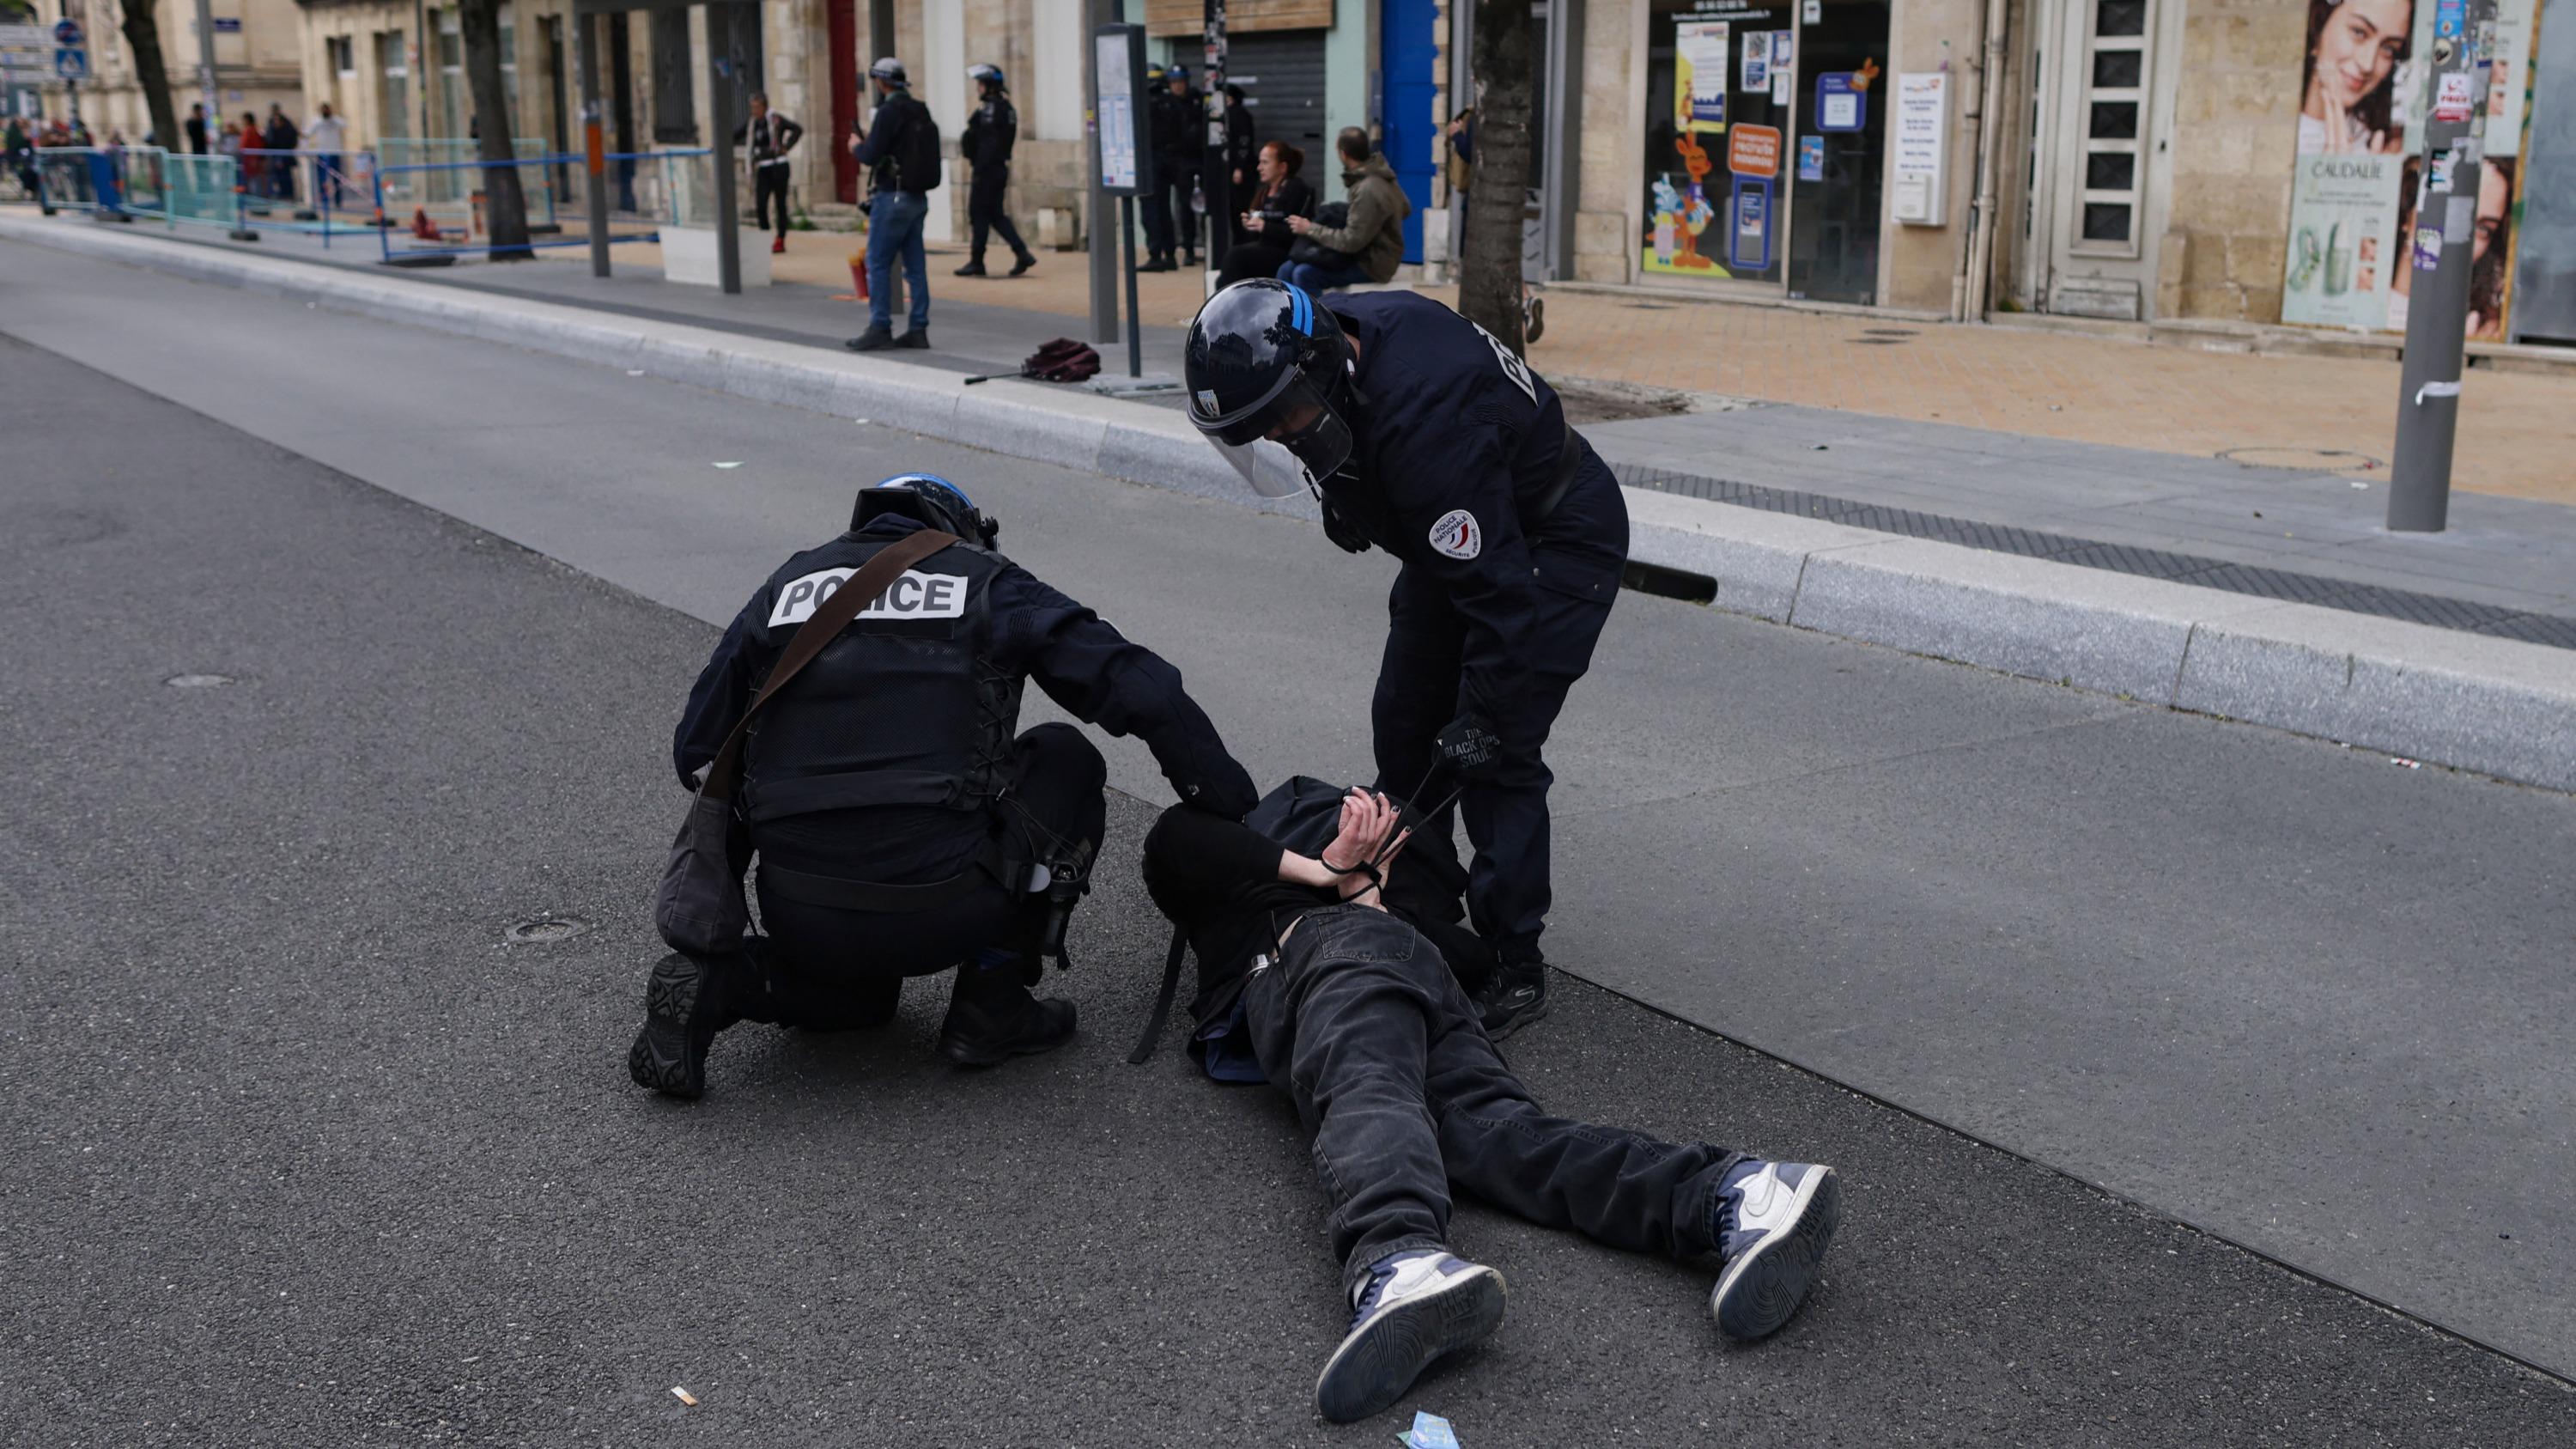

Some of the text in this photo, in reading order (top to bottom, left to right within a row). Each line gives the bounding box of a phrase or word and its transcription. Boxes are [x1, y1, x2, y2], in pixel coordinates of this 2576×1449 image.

[1433, 515, 1467, 543] NATIONALE
[1436, 515, 1457, 534] POLICE
[1465, 728, 1482, 739] THE
[1444, 740, 1477, 758] BLACK
[1461, 748, 1492, 768] SOUL
